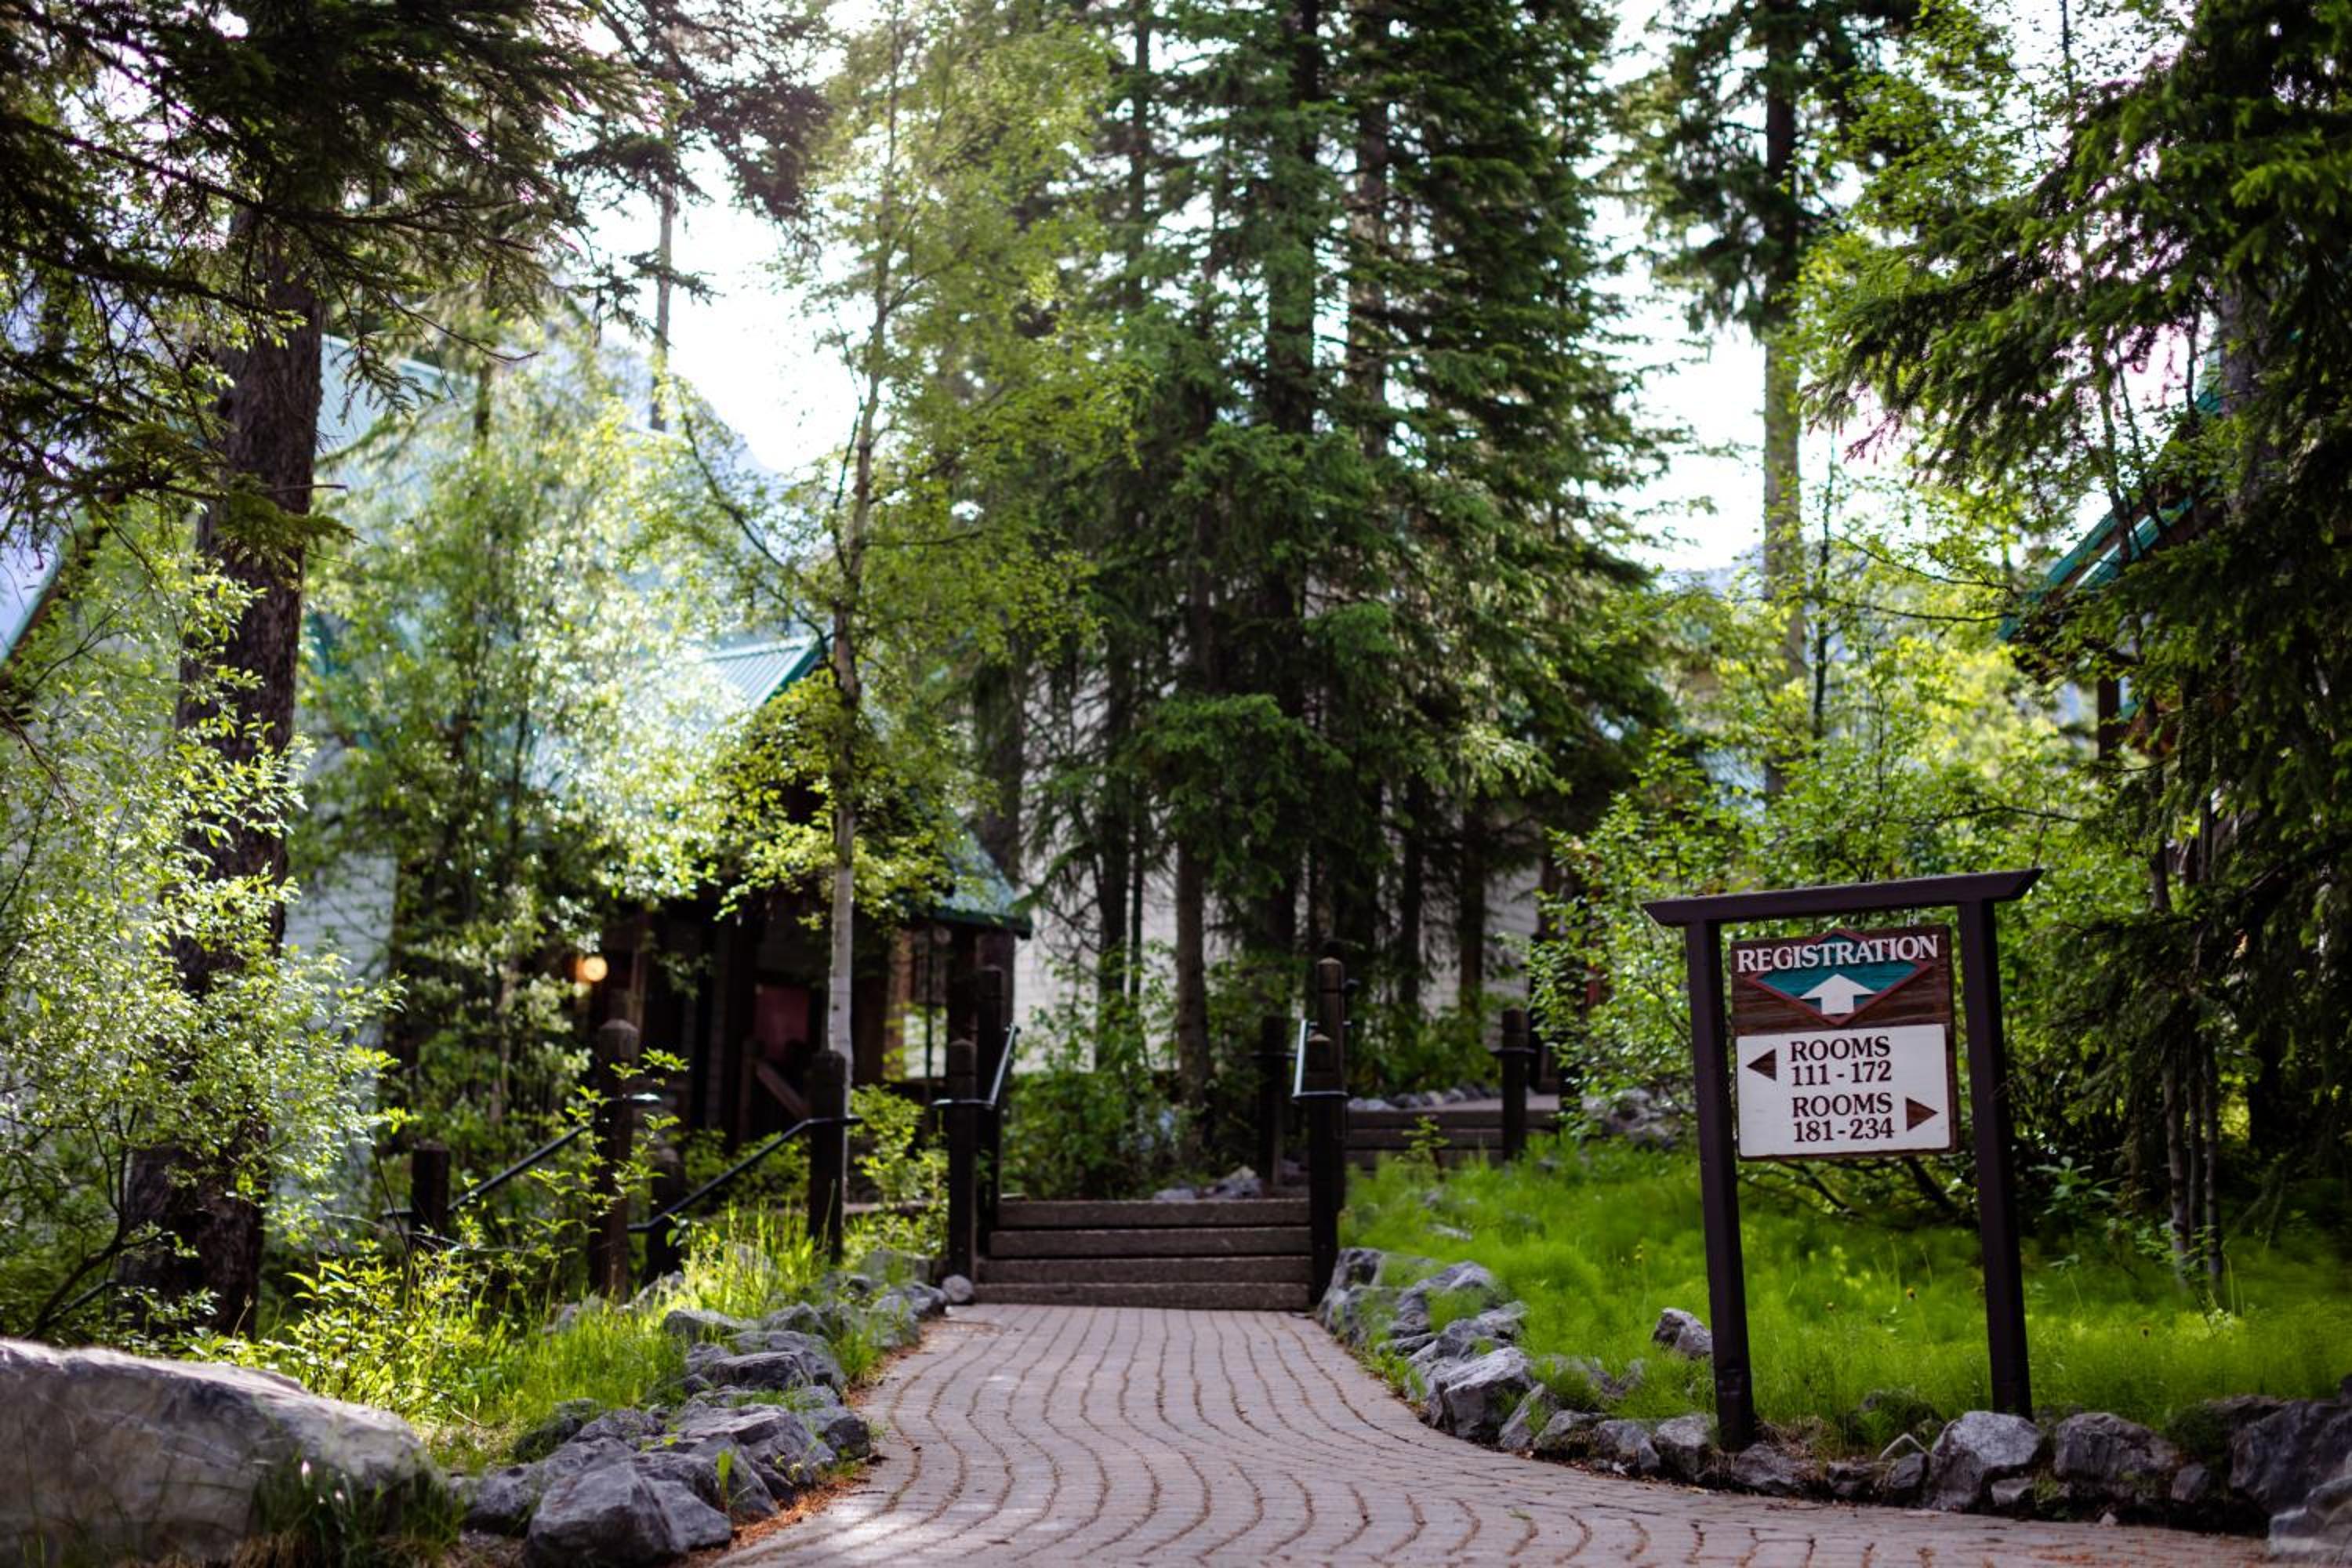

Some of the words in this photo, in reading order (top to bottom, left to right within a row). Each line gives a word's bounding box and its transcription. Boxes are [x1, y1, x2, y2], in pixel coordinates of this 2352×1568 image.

[1737, 935, 1939, 973] REGISTRATION
[1790, 1036, 1891, 1062] ROOMS
[1792, 1092, 1893, 1118] ROOMS
